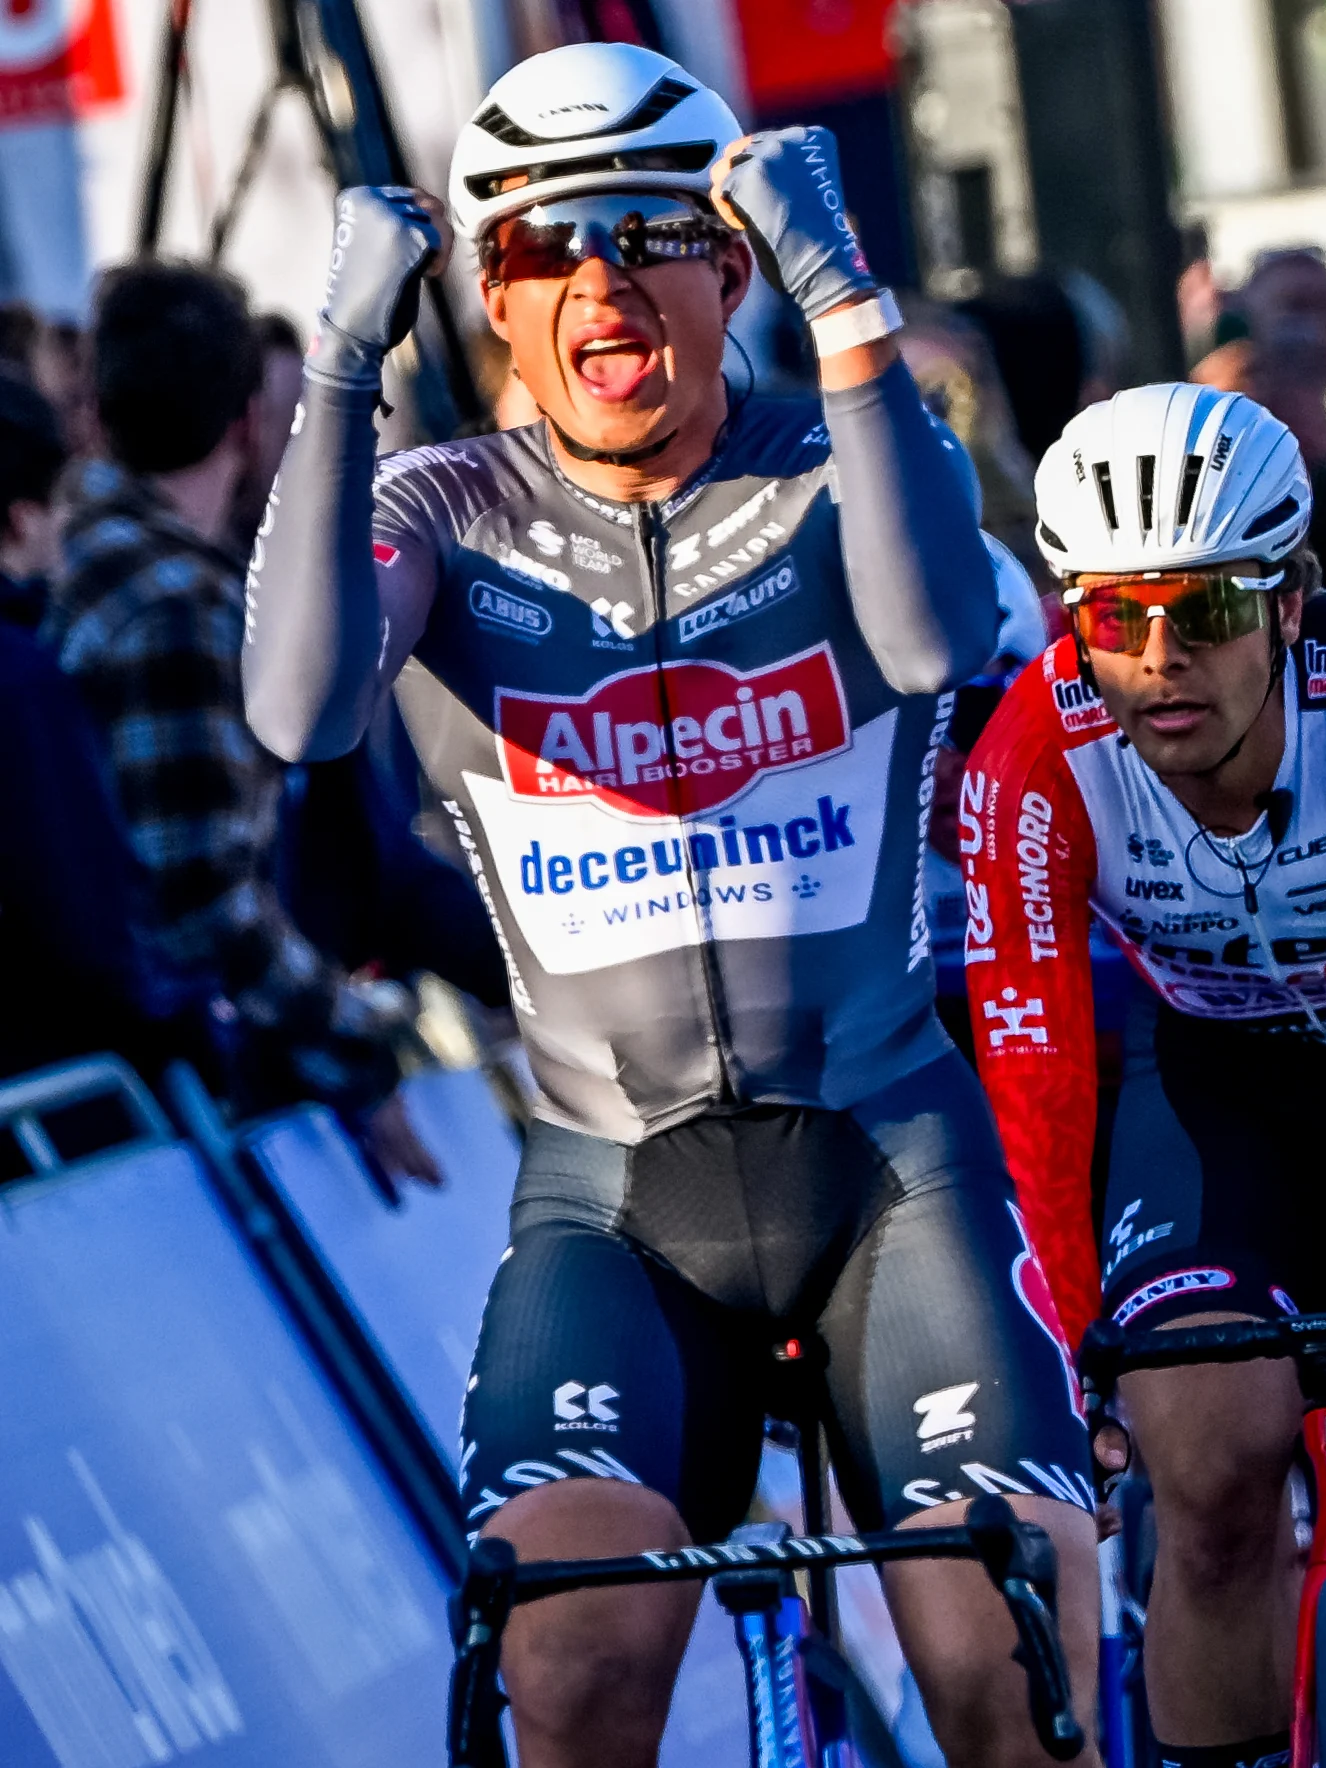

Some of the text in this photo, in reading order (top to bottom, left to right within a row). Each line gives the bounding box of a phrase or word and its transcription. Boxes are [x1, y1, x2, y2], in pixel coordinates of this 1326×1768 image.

[1210, 433, 1233, 472] uvex
[571, 544, 624, 568] WORLD
[574, 554, 612, 574] TEAM
[673, 522, 786, 597] CANYON
[479, 590, 541, 628] ABUS
[536, 686, 812, 786] Alpecin
[538, 737, 813, 794] HAIR BOOSTER
[519, 794, 856, 897] deceuninck
[1016, 790, 1060, 964] TECHNORD
[1125, 877, 1186, 902] uvex
[603, 881, 774, 927] WINDOWS
[642, 1536, 868, 1569] CANYON
